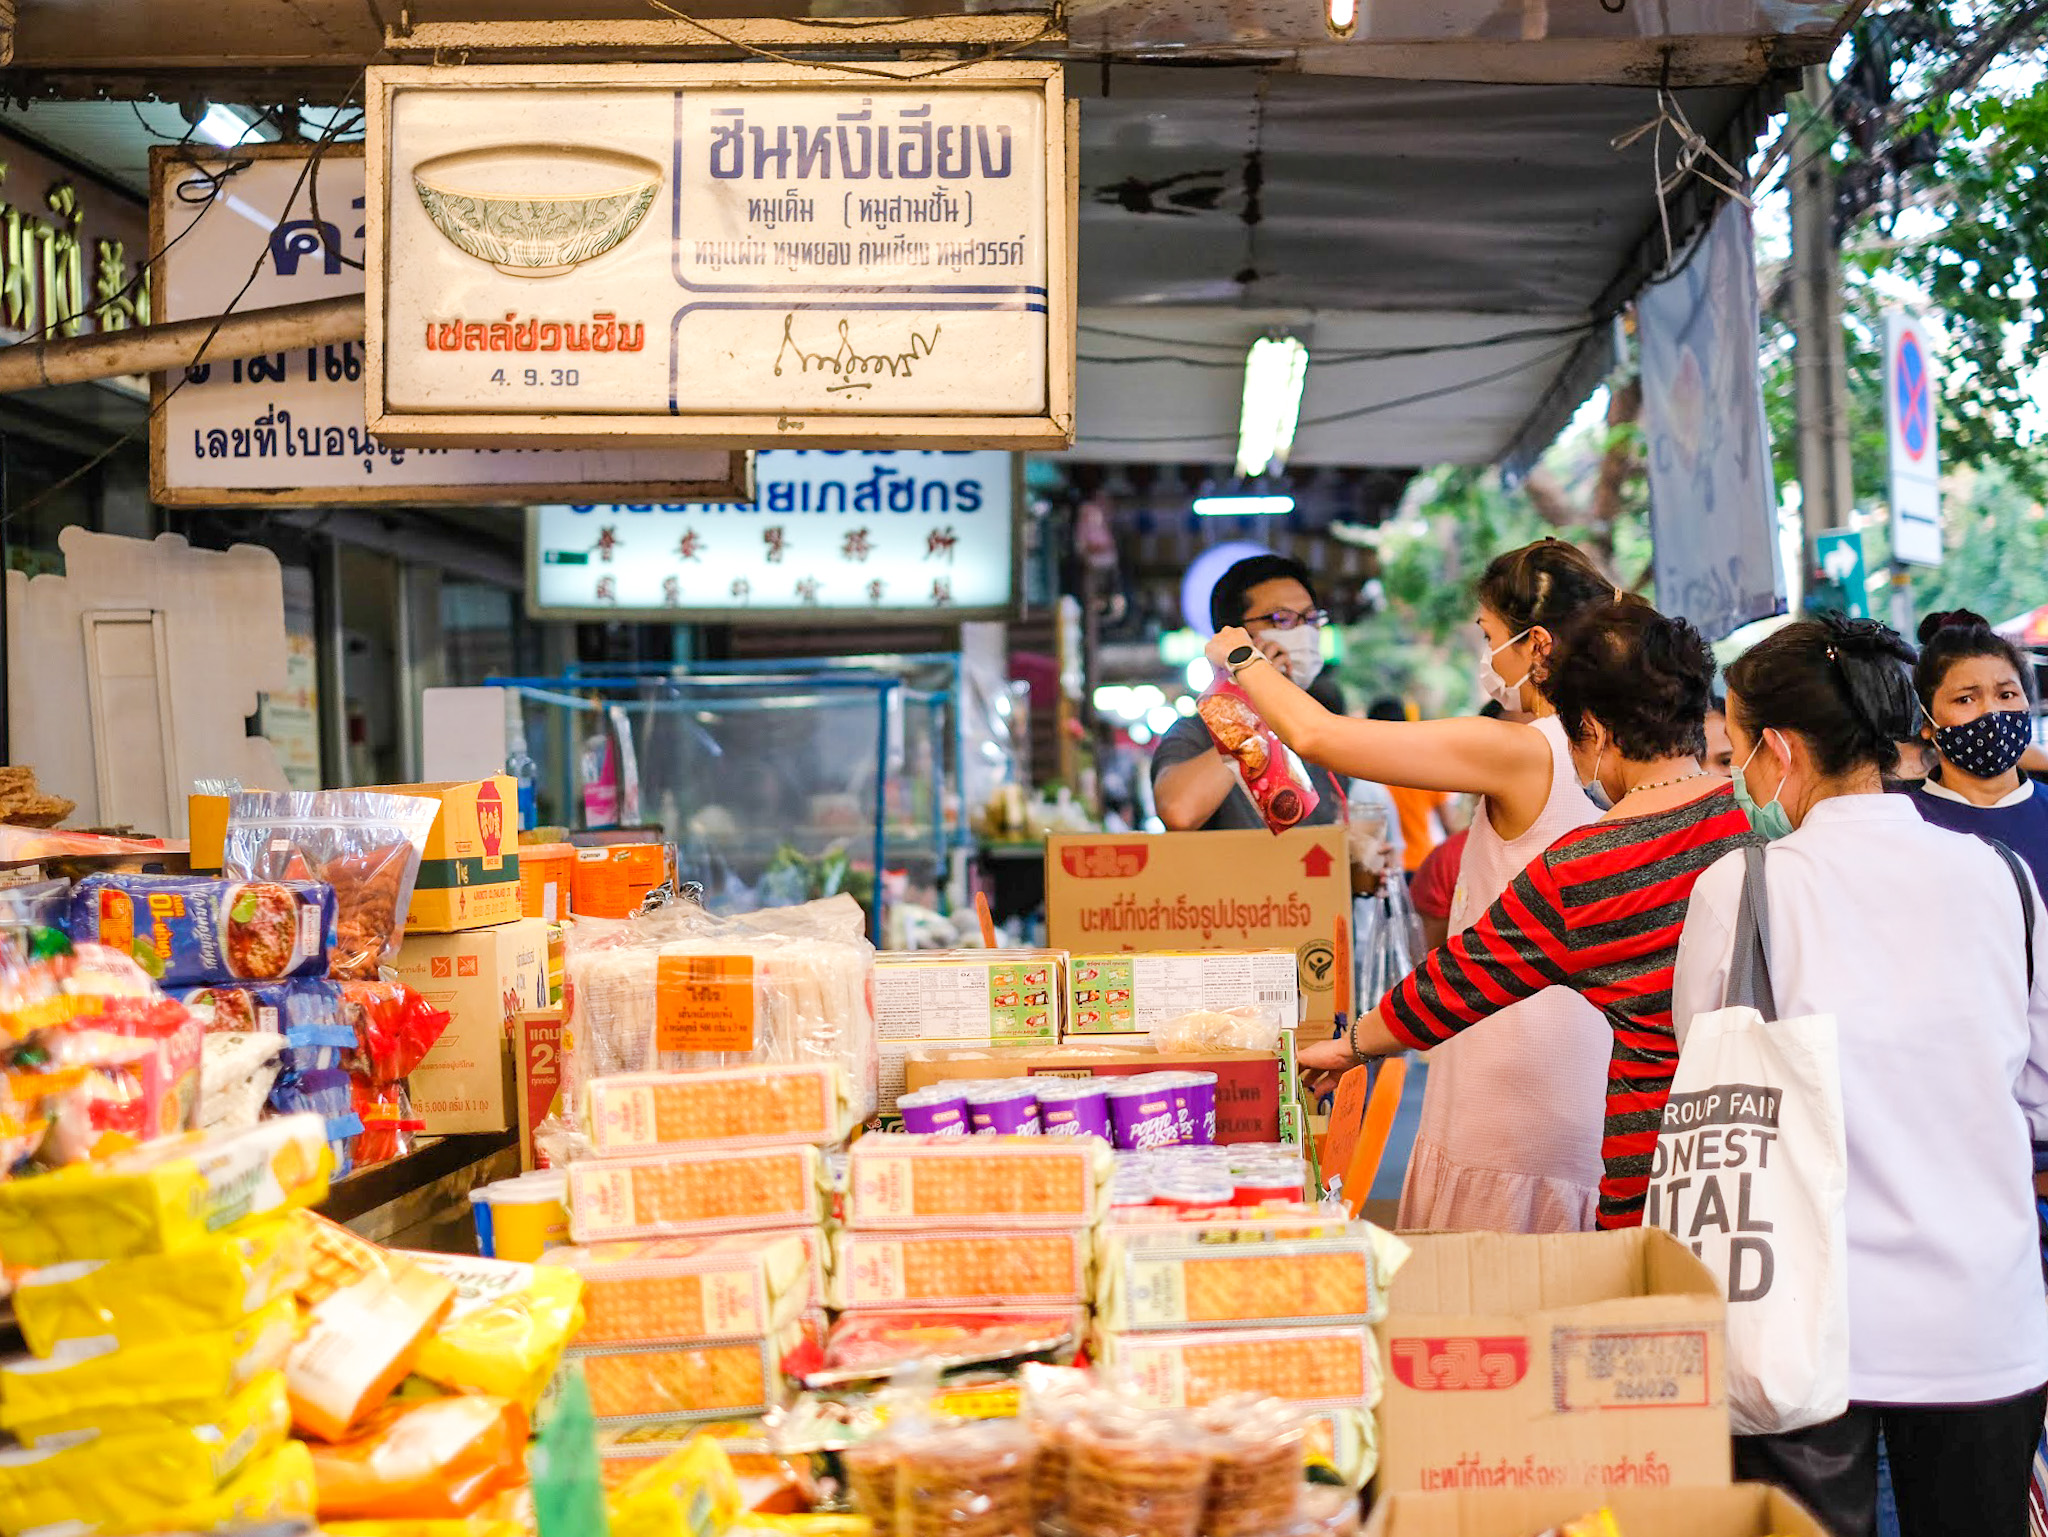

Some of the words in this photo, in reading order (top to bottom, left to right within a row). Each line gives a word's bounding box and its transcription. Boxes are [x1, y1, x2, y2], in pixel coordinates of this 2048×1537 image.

[747, 189, 814, 230] หมูเค็ม
[694, 235, 766, 272] หมูแผ่น
[773, 240, 850, 273] หมูหยอง
[859, 233, 931, 272] กุนเชียง
[936, 234, 1025, 273] หมูสวรรค์
[426, 312, 645, 351] เชลล์ชวนชิม
[531, 1043, 556, 1075] 2
[1129, 1112, 1173, 1141] POTATO
[1663, 1095, 1721, 1125] ROUP
[1729, 1092, 1776, 1119] FAIR
[1650, 1128, 1778, 1179] ONEST
[1649, 1172, 1774, 1238] ITAL
